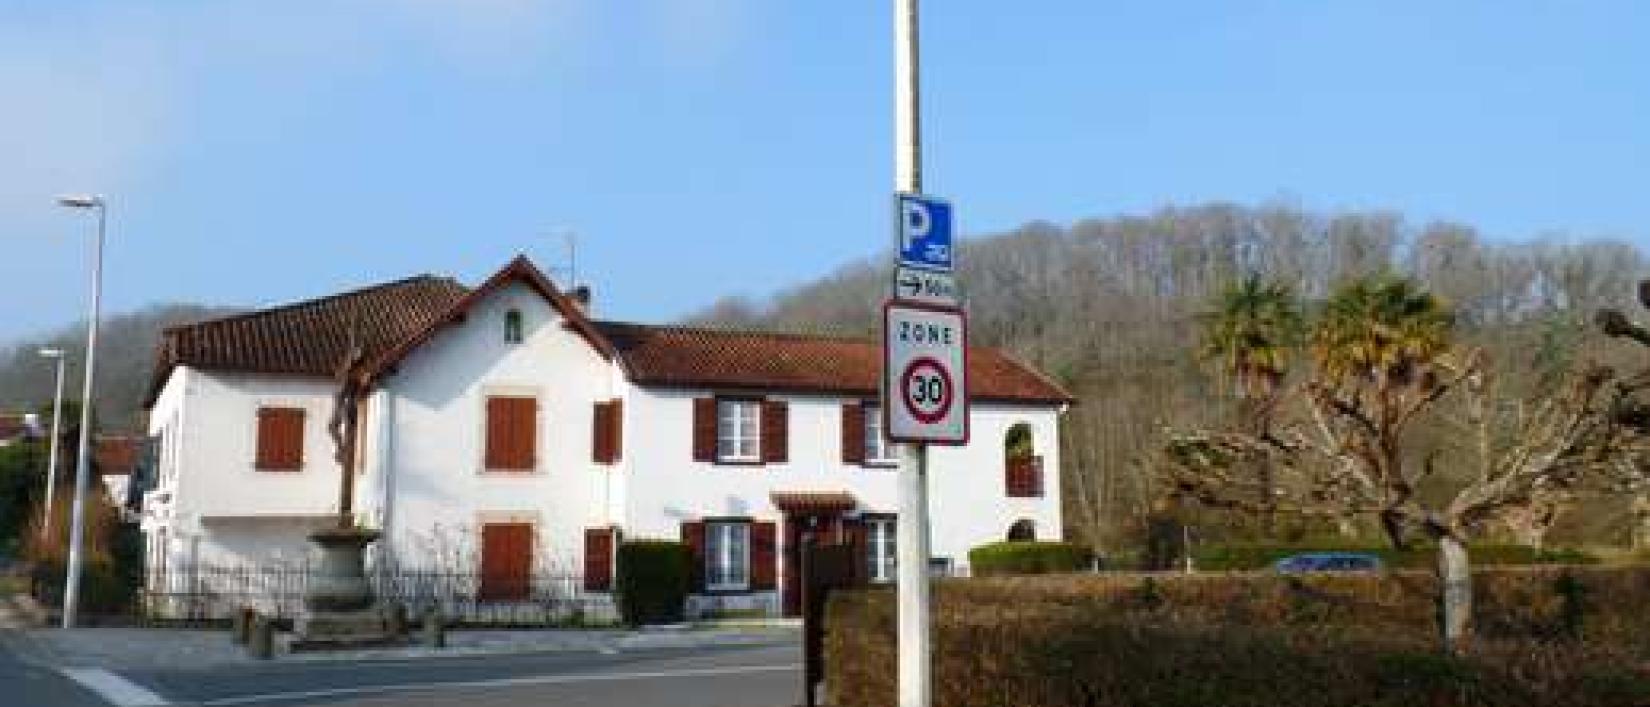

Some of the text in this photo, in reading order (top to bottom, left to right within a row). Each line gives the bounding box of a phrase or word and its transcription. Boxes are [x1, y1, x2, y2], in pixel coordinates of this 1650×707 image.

[902, 202, 931, 251] P
[900, 321, 953, 344] ZONE
[911, 375, 943, 403] 30
